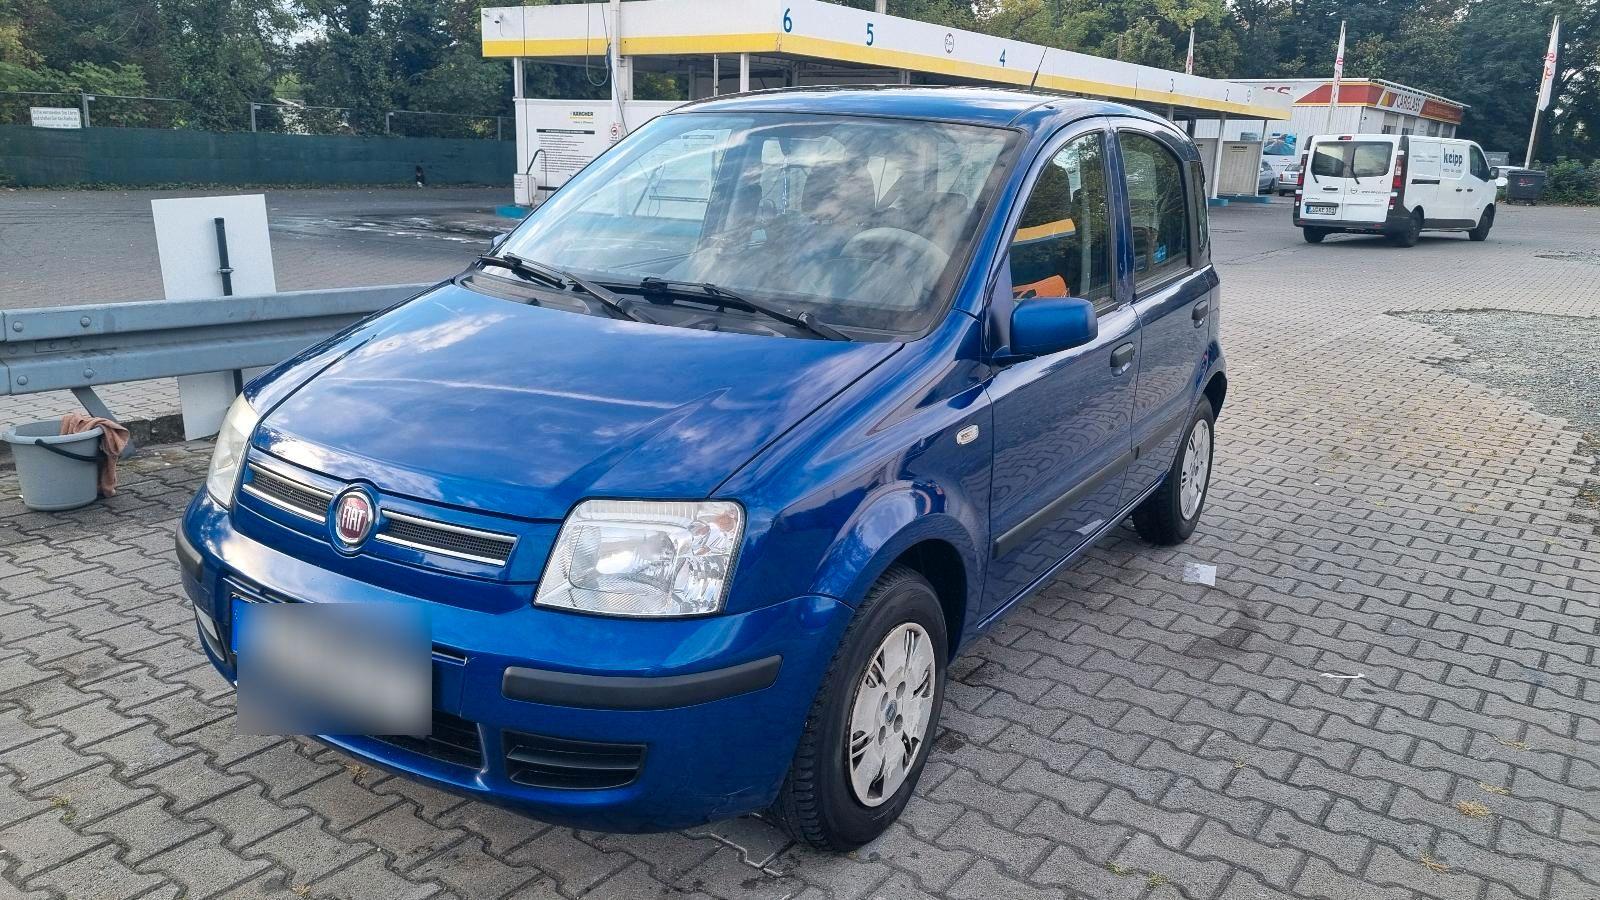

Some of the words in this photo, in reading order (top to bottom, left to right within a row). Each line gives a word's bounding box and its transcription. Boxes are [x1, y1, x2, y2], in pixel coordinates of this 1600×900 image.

[783, 8, 792, 33] 6
[866, 22, 874, 46] 5
[999, 48, 1005, 67] 4
[1396, 93, 1421, 112] CARGLASS
[1443, 147, 1463, 167] keipp
[341, 505, 366, 531] FIAT
